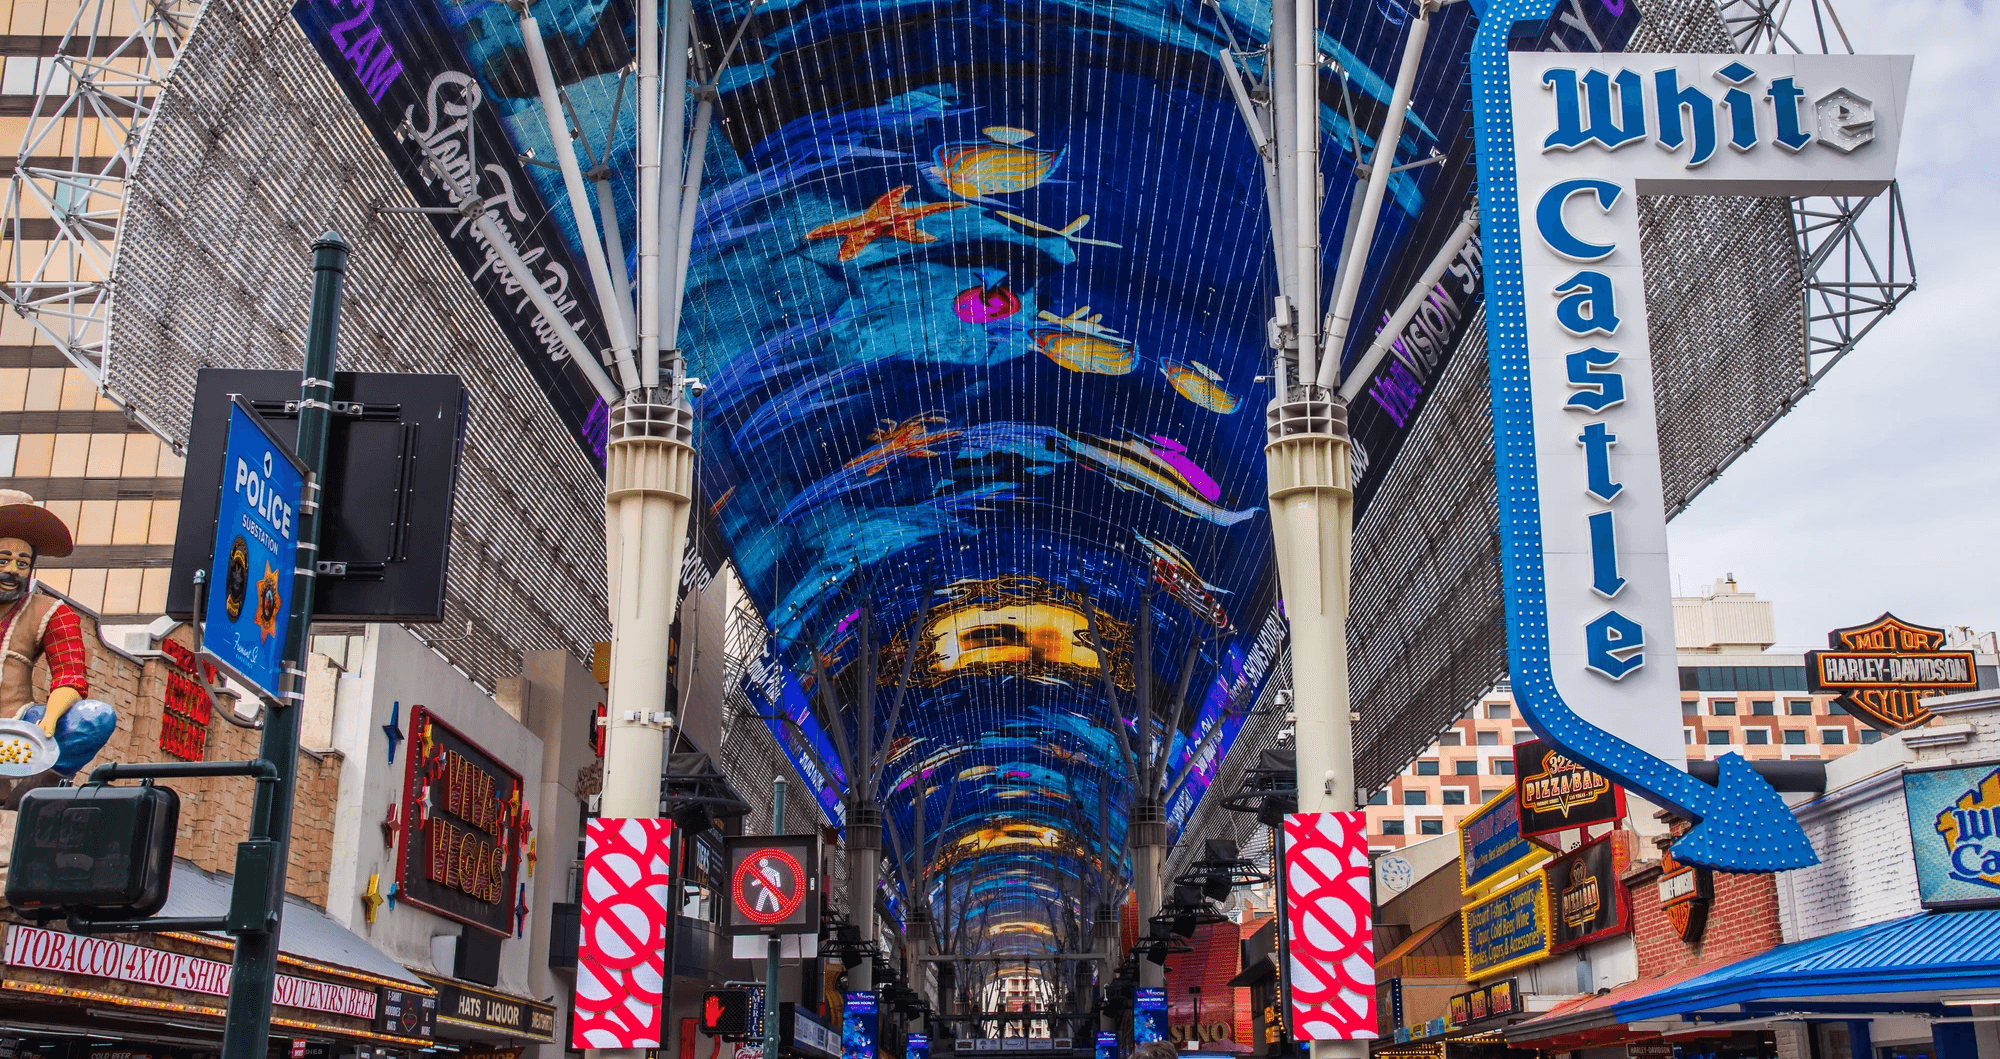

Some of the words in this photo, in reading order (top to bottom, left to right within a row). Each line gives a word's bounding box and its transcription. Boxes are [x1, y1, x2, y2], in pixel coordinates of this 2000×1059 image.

[1541, 60, 1876, 169] White
[1535, 178, 1646, 681] Castle
[235, 457, 291, 540] POLICE
[242, 514, 279, 556] SUBSTATION
[1855, 624, 1929, 650] MOTOR
[1243, 641, 1270, 688] SHOWS
[1825, 656, 1968, 683] HARLEY-DAVIDSON
[1863, 688, 1944, 724] CYCLE
[446, 749, 498, 836] VIVA
[1526, 775, 1570, 802] PIZZA
[1572, 770, 1604, 792] BAR
[430, 816, 504, 905] VEGAS
[1470, 904, 1490, 930] Discount
[1491, 918, 1503, 939] Cold
[1516, 908, 1530, 931] Wine
[18, 928, 120, 977] TOBACCO
[1510, 926, 1541, 954] Accessories
[274, 975, 345, 1012] SOUVENIRS
[347, 988, 377, 1018] BEER
[458, 995, 481, 1018] HATS
[486, 1001, 520, 1026] LIQUOR
